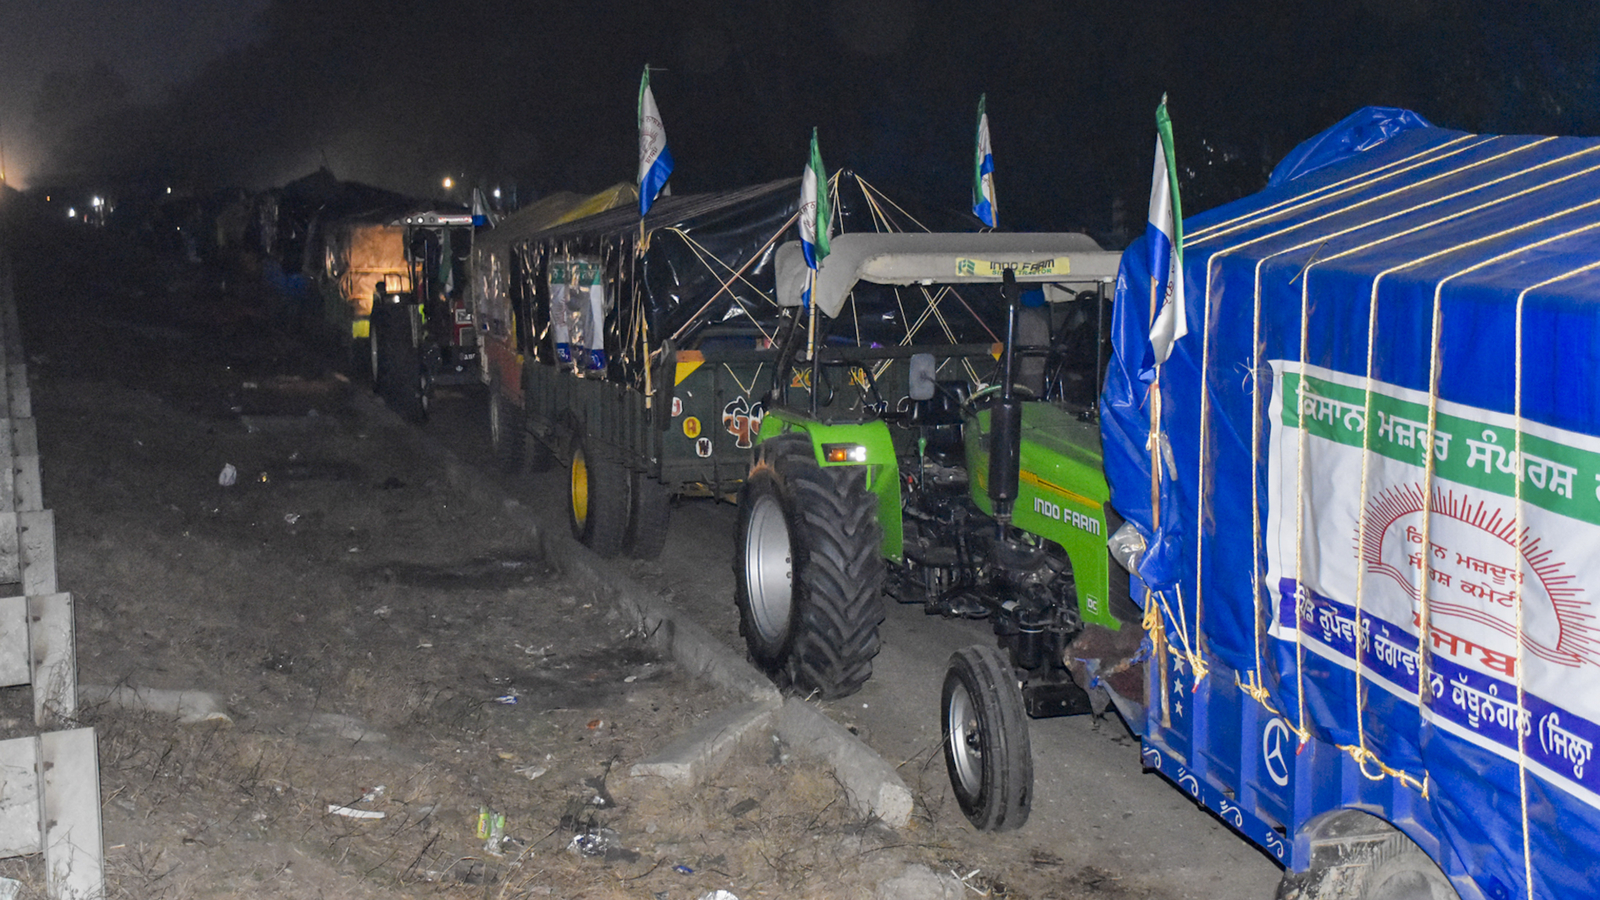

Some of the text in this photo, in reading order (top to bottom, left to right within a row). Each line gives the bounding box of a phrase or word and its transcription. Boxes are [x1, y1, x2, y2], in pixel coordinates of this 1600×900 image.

[990, 258, 1055, 271] INDO FARM
[1295, 379, 1366, 433] ਕਿਸਾਨ
[1378, 410, 1452, 465] ਮਜ਼ਦੂਰ
[1466, 429, 1578, 499] ਸੰਘਰਸ਼
[1034, 497, 1100, 536] INDO FARM
[1408, 552, 1452, 588] ਸੰਰਸ਼
[1087, 598, 1097, 611] DC
